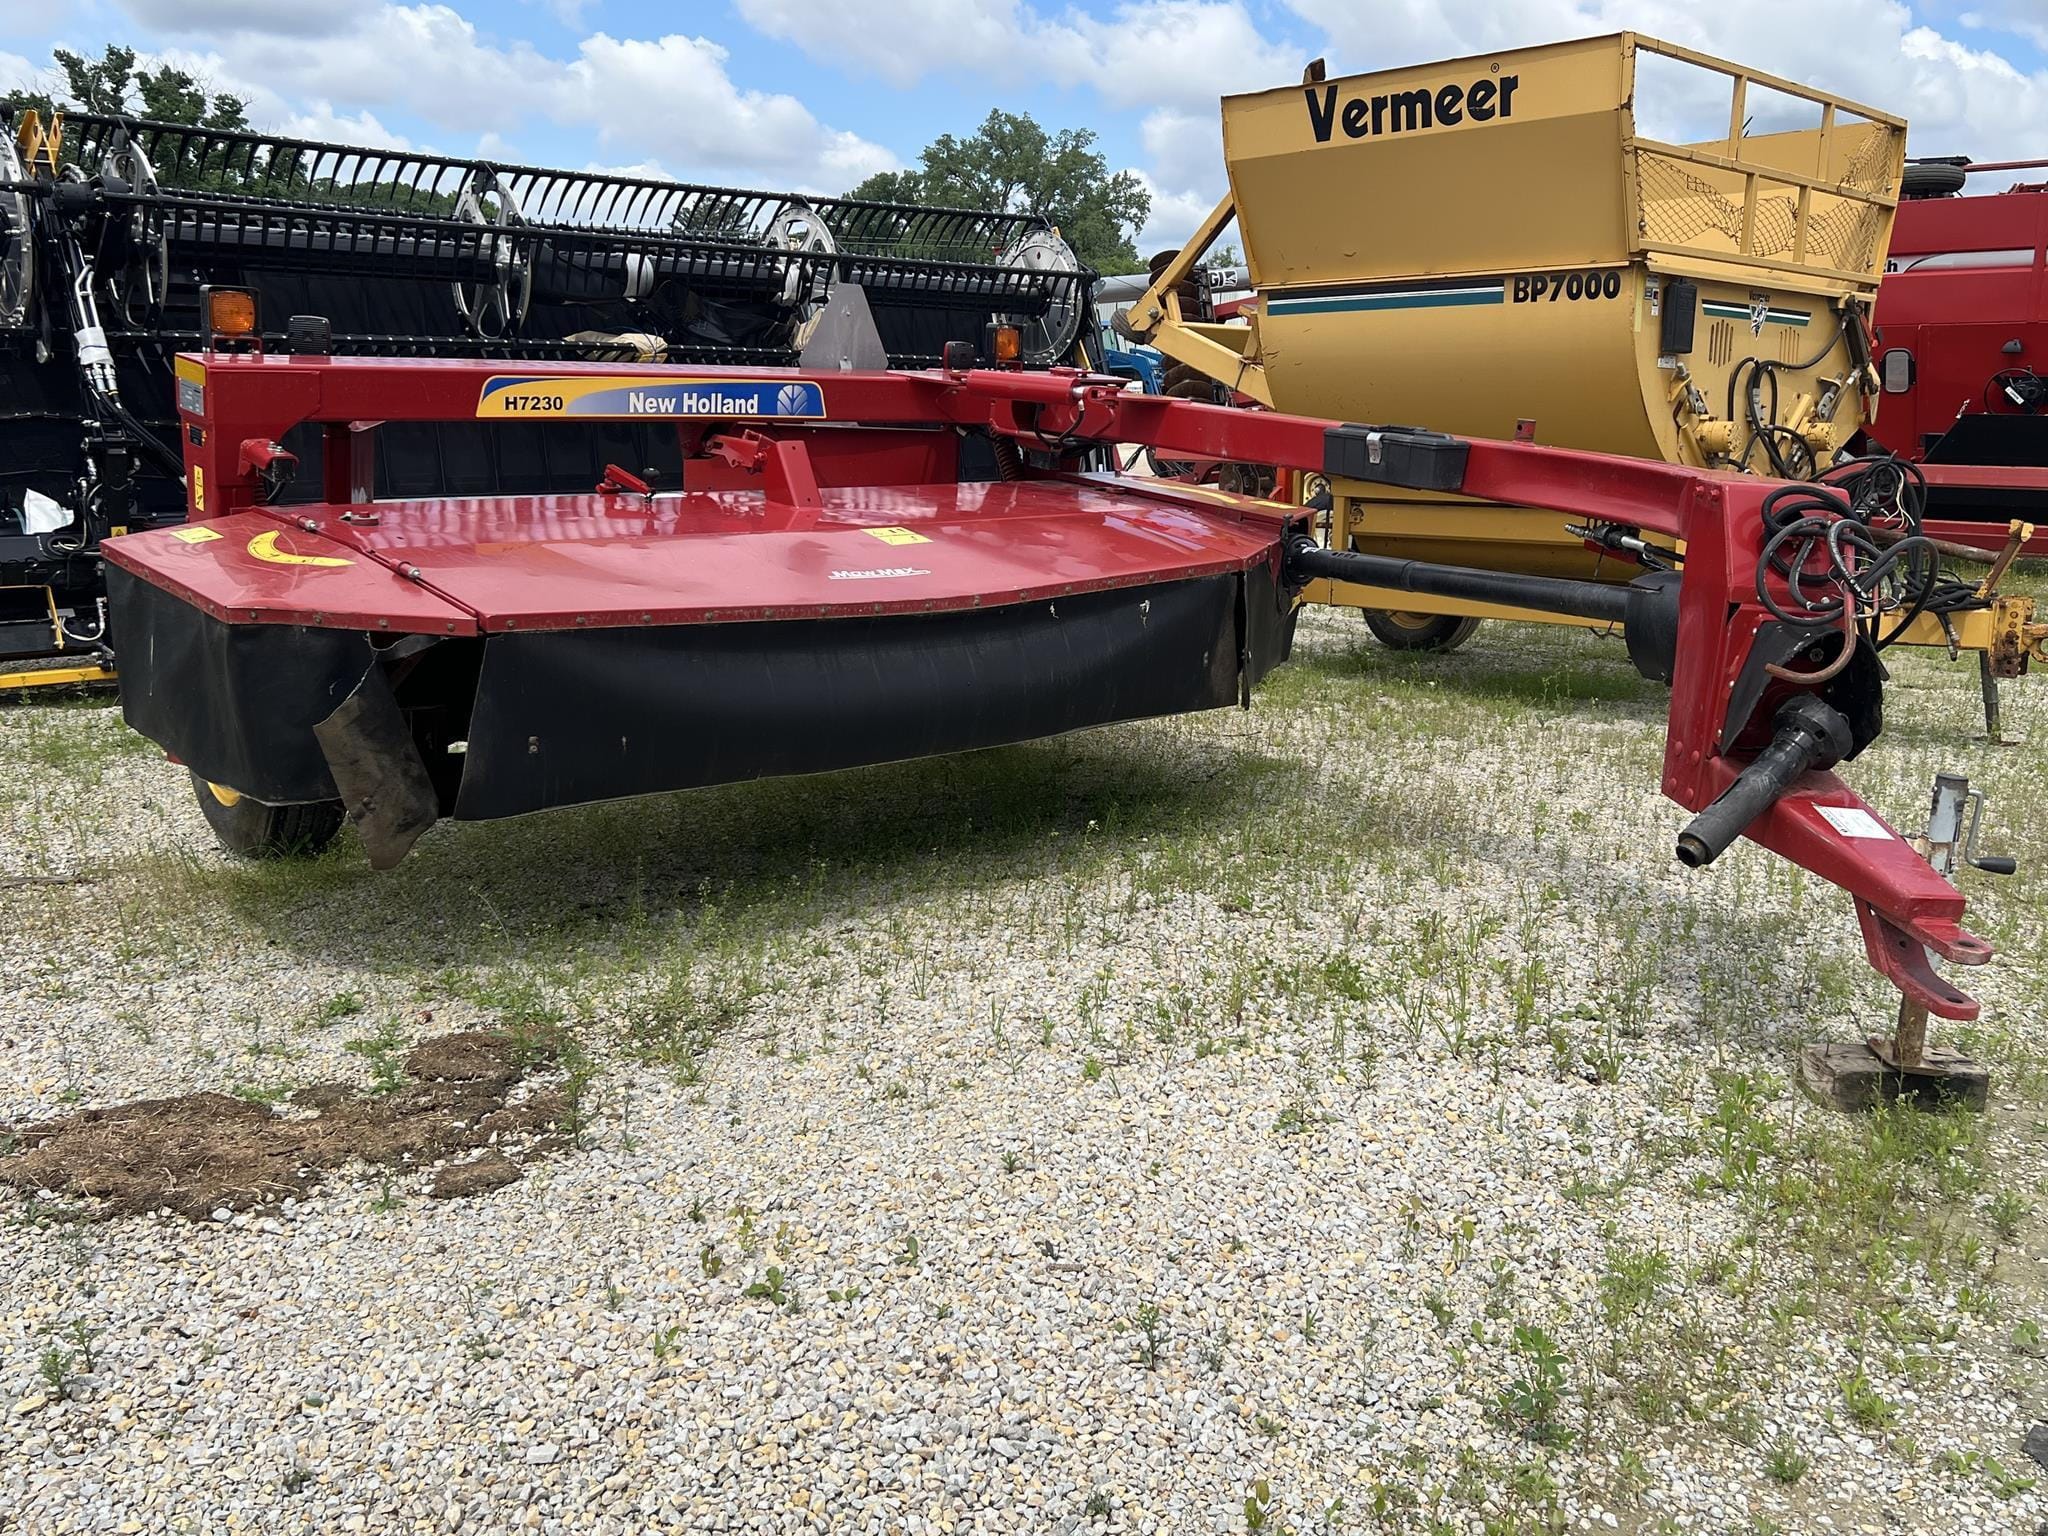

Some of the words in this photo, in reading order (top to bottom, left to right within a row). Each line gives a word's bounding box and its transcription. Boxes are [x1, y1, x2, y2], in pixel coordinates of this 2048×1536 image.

[1305, 75, 1519, 143] Vermeer
[1513, 271, 1621, 303] BP7000
[504, 396, 564, 411] H7230
[629, 392, 674, 413] New
[682, 394, 759, 415] Holland
